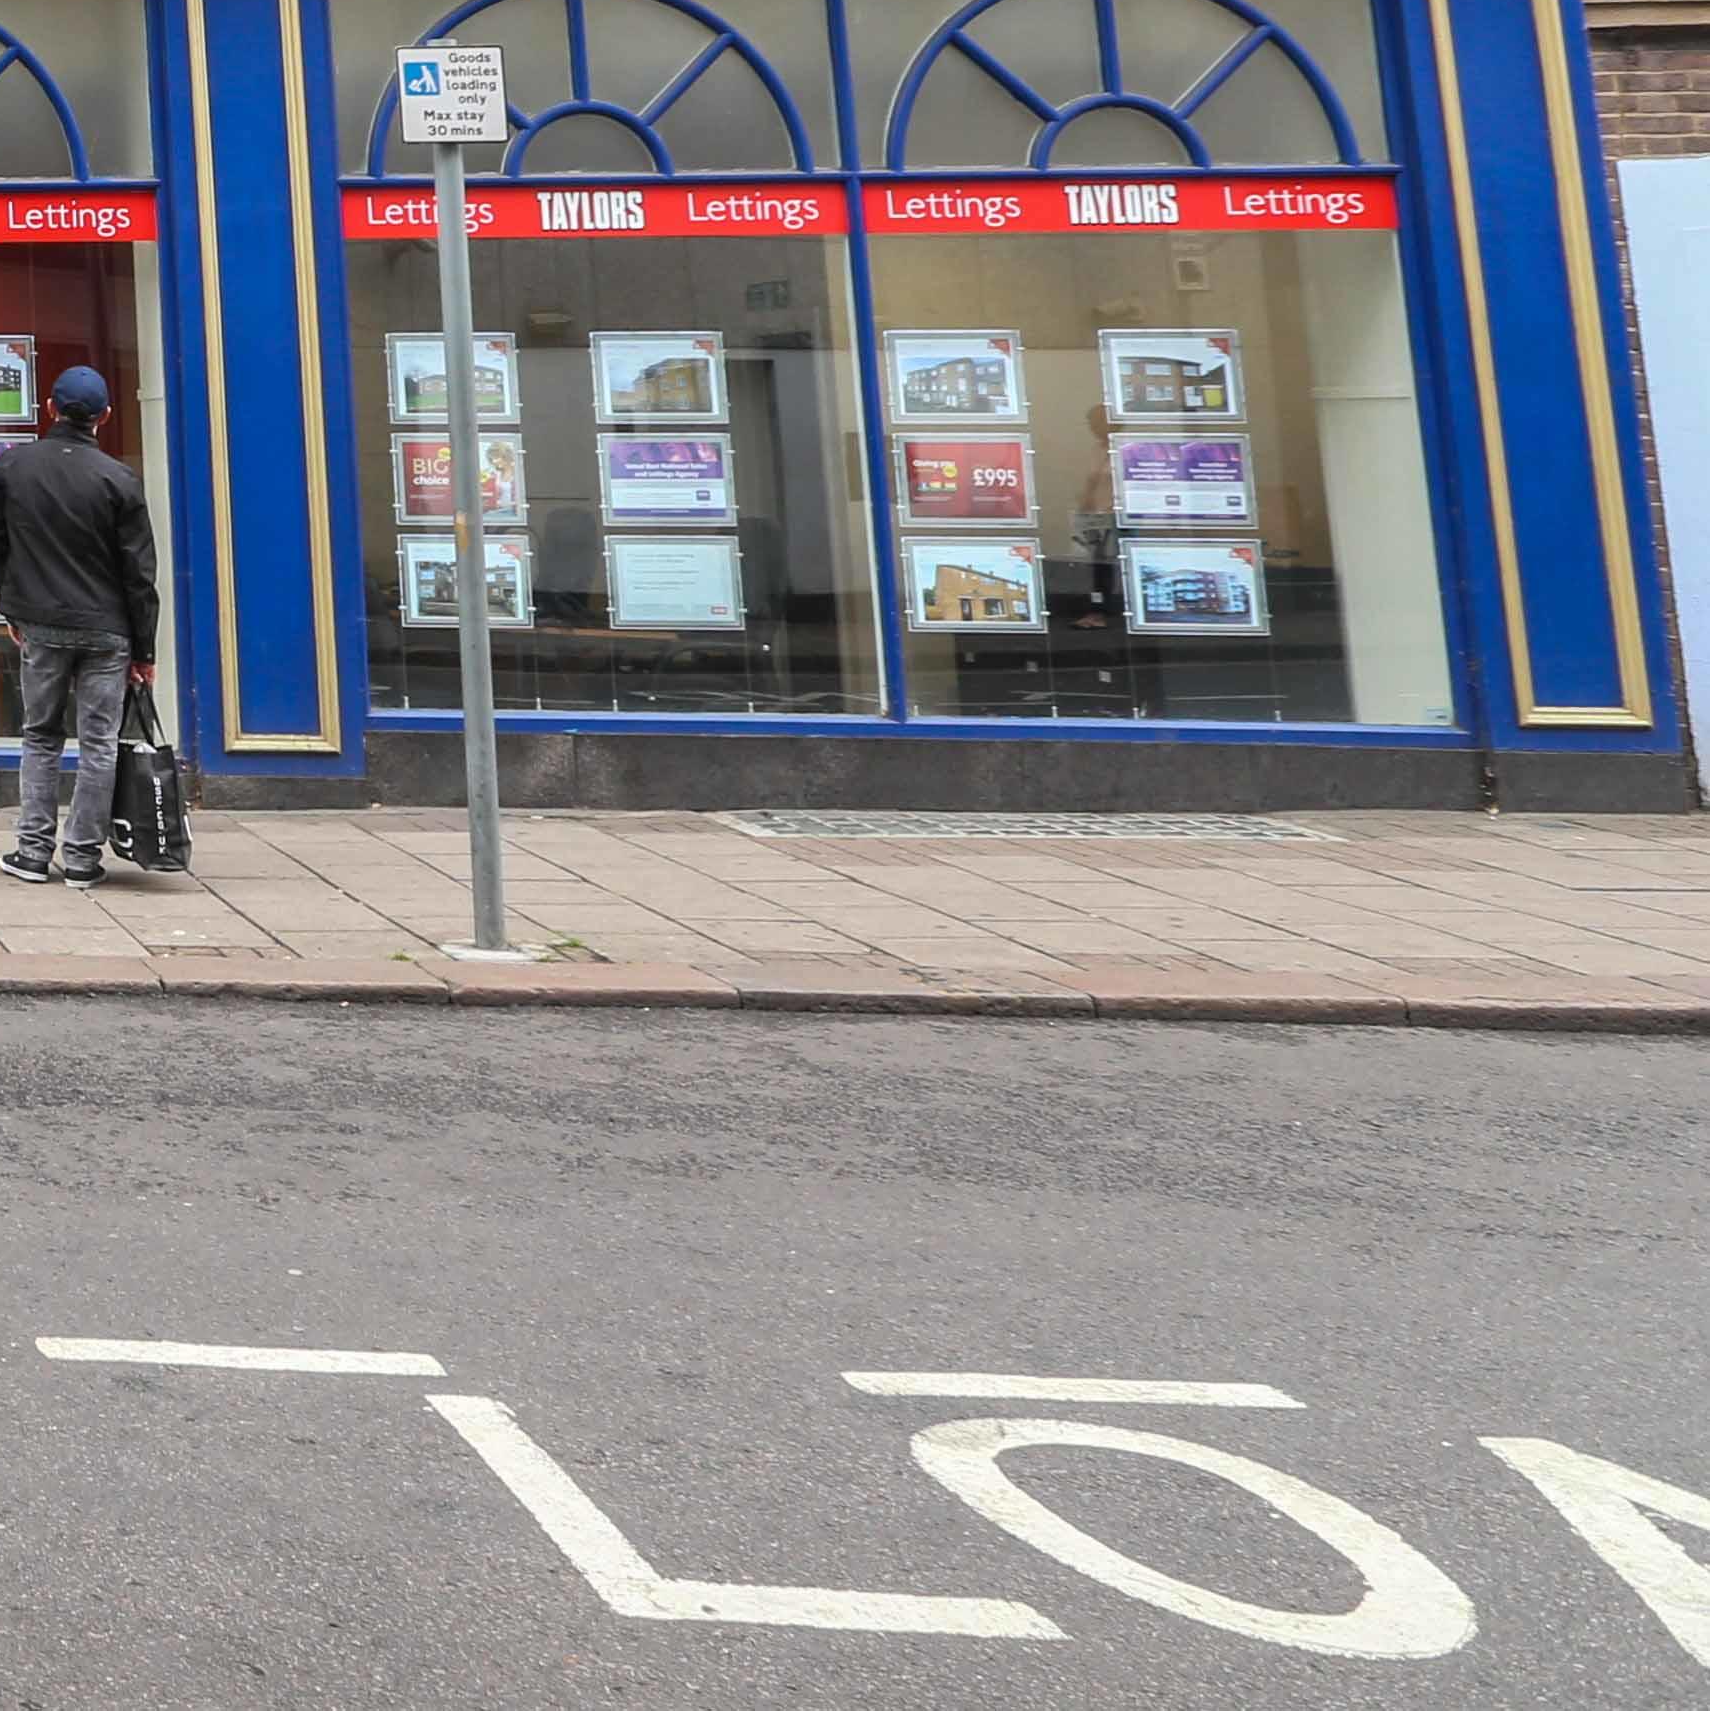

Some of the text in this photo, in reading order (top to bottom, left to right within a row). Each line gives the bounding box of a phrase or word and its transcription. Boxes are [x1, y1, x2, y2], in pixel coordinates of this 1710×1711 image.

[448, 52, 492, 64] Goods
[443, 66, 499, 77] vehicles
[446, 79, 497, 92] loading
[458, 93, 487, 106] only
[423, 110, 486, 123] Max stay
[427, 125, 484, 136] 30 mins
[365, 191, 820, 233] Lettigs TAYLORS Lettings
[884, 184, 1366, 227] Lettings TAYLORS Lettings
[6, 199, 132, 237] Lettings
[412, 458, 450, 475] BIG
[412, 475, 450, 486] choice
[972, 468, 1019, 487] £995
